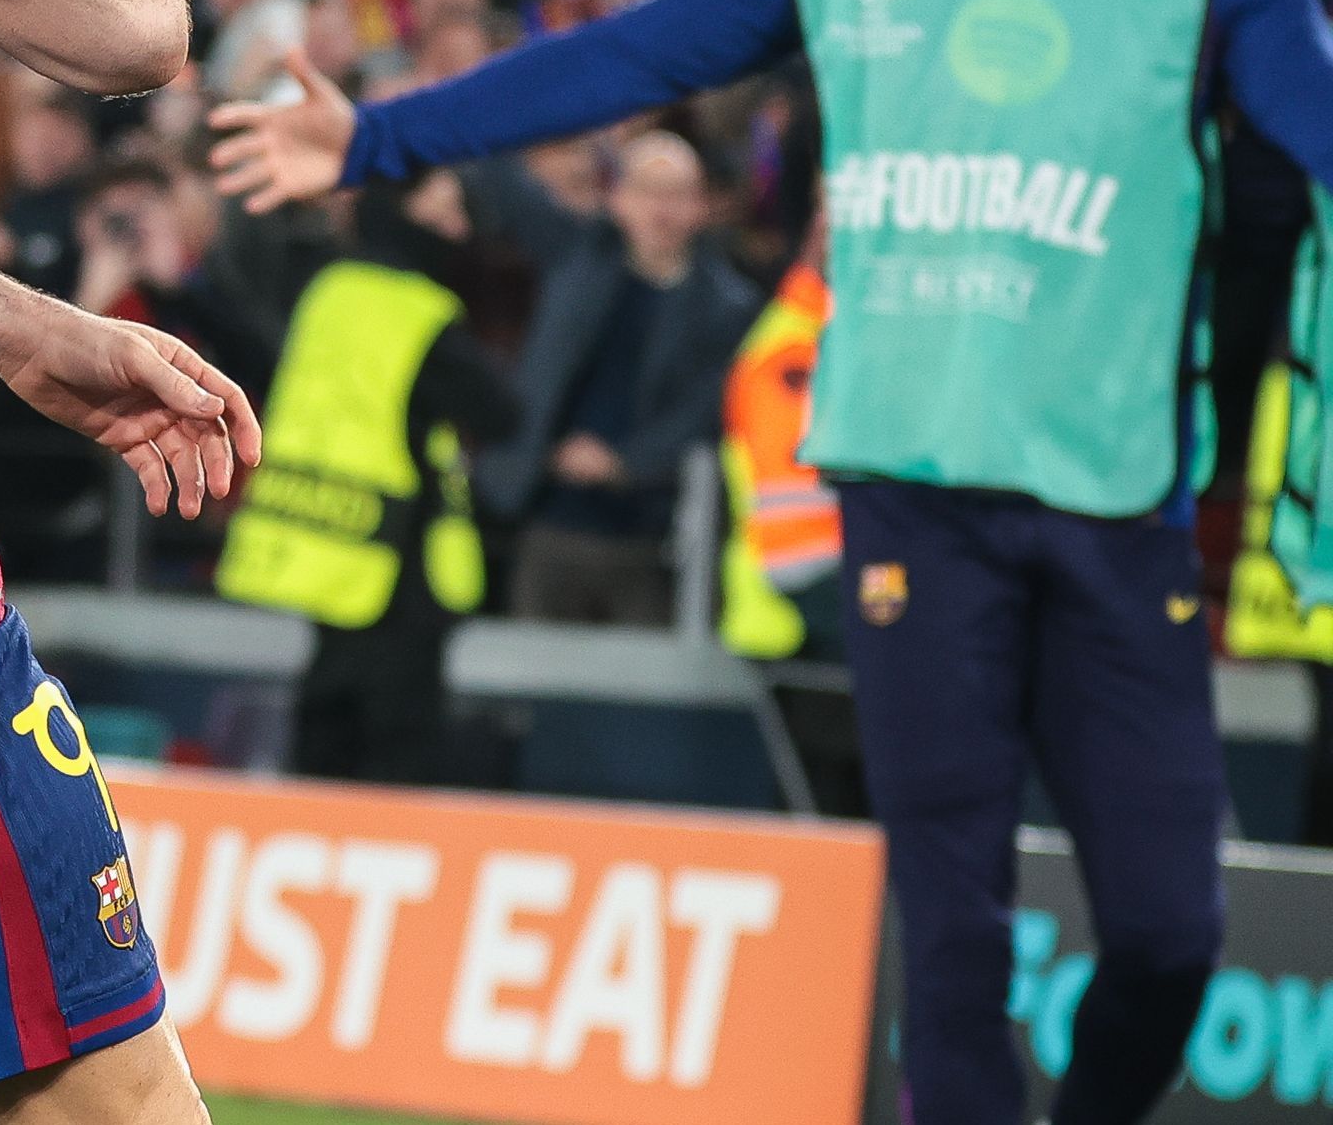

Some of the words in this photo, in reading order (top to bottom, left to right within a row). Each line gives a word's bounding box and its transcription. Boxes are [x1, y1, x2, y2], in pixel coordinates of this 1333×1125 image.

[829, 151, 1119, 257] #FOOTBALL
[11, 680, 120, 833] 9
[445, 853, 781, 1089] EAT
